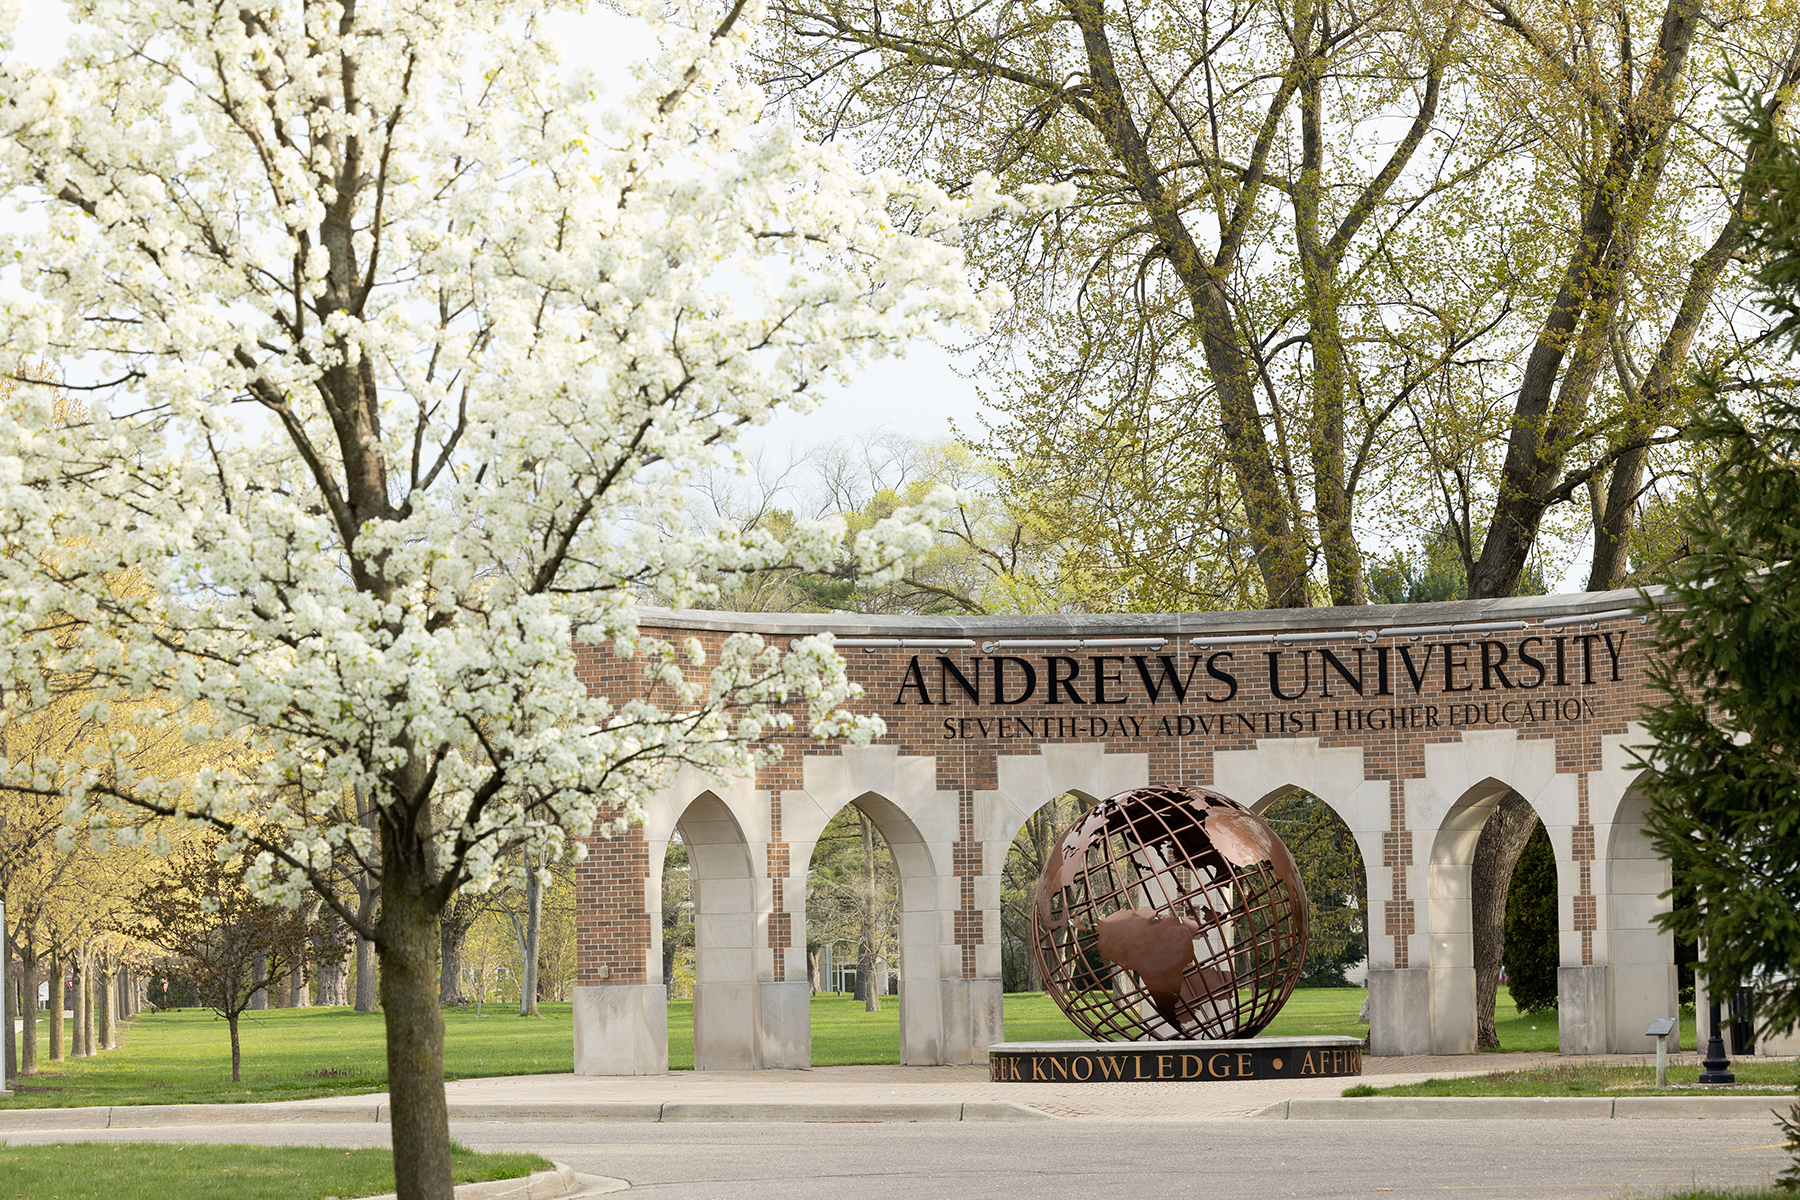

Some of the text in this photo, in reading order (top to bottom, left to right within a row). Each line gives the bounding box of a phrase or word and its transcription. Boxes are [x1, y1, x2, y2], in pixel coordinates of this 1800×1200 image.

[893, 631, 1628, 706] ANDREWS UNIVERSITY
[943, 697, 1595, 740] SEVENTH-DAY ADVENTIST HIGHER EDUCATION
[1031, 1053, 1254, 1081] KNOWLEDGE
